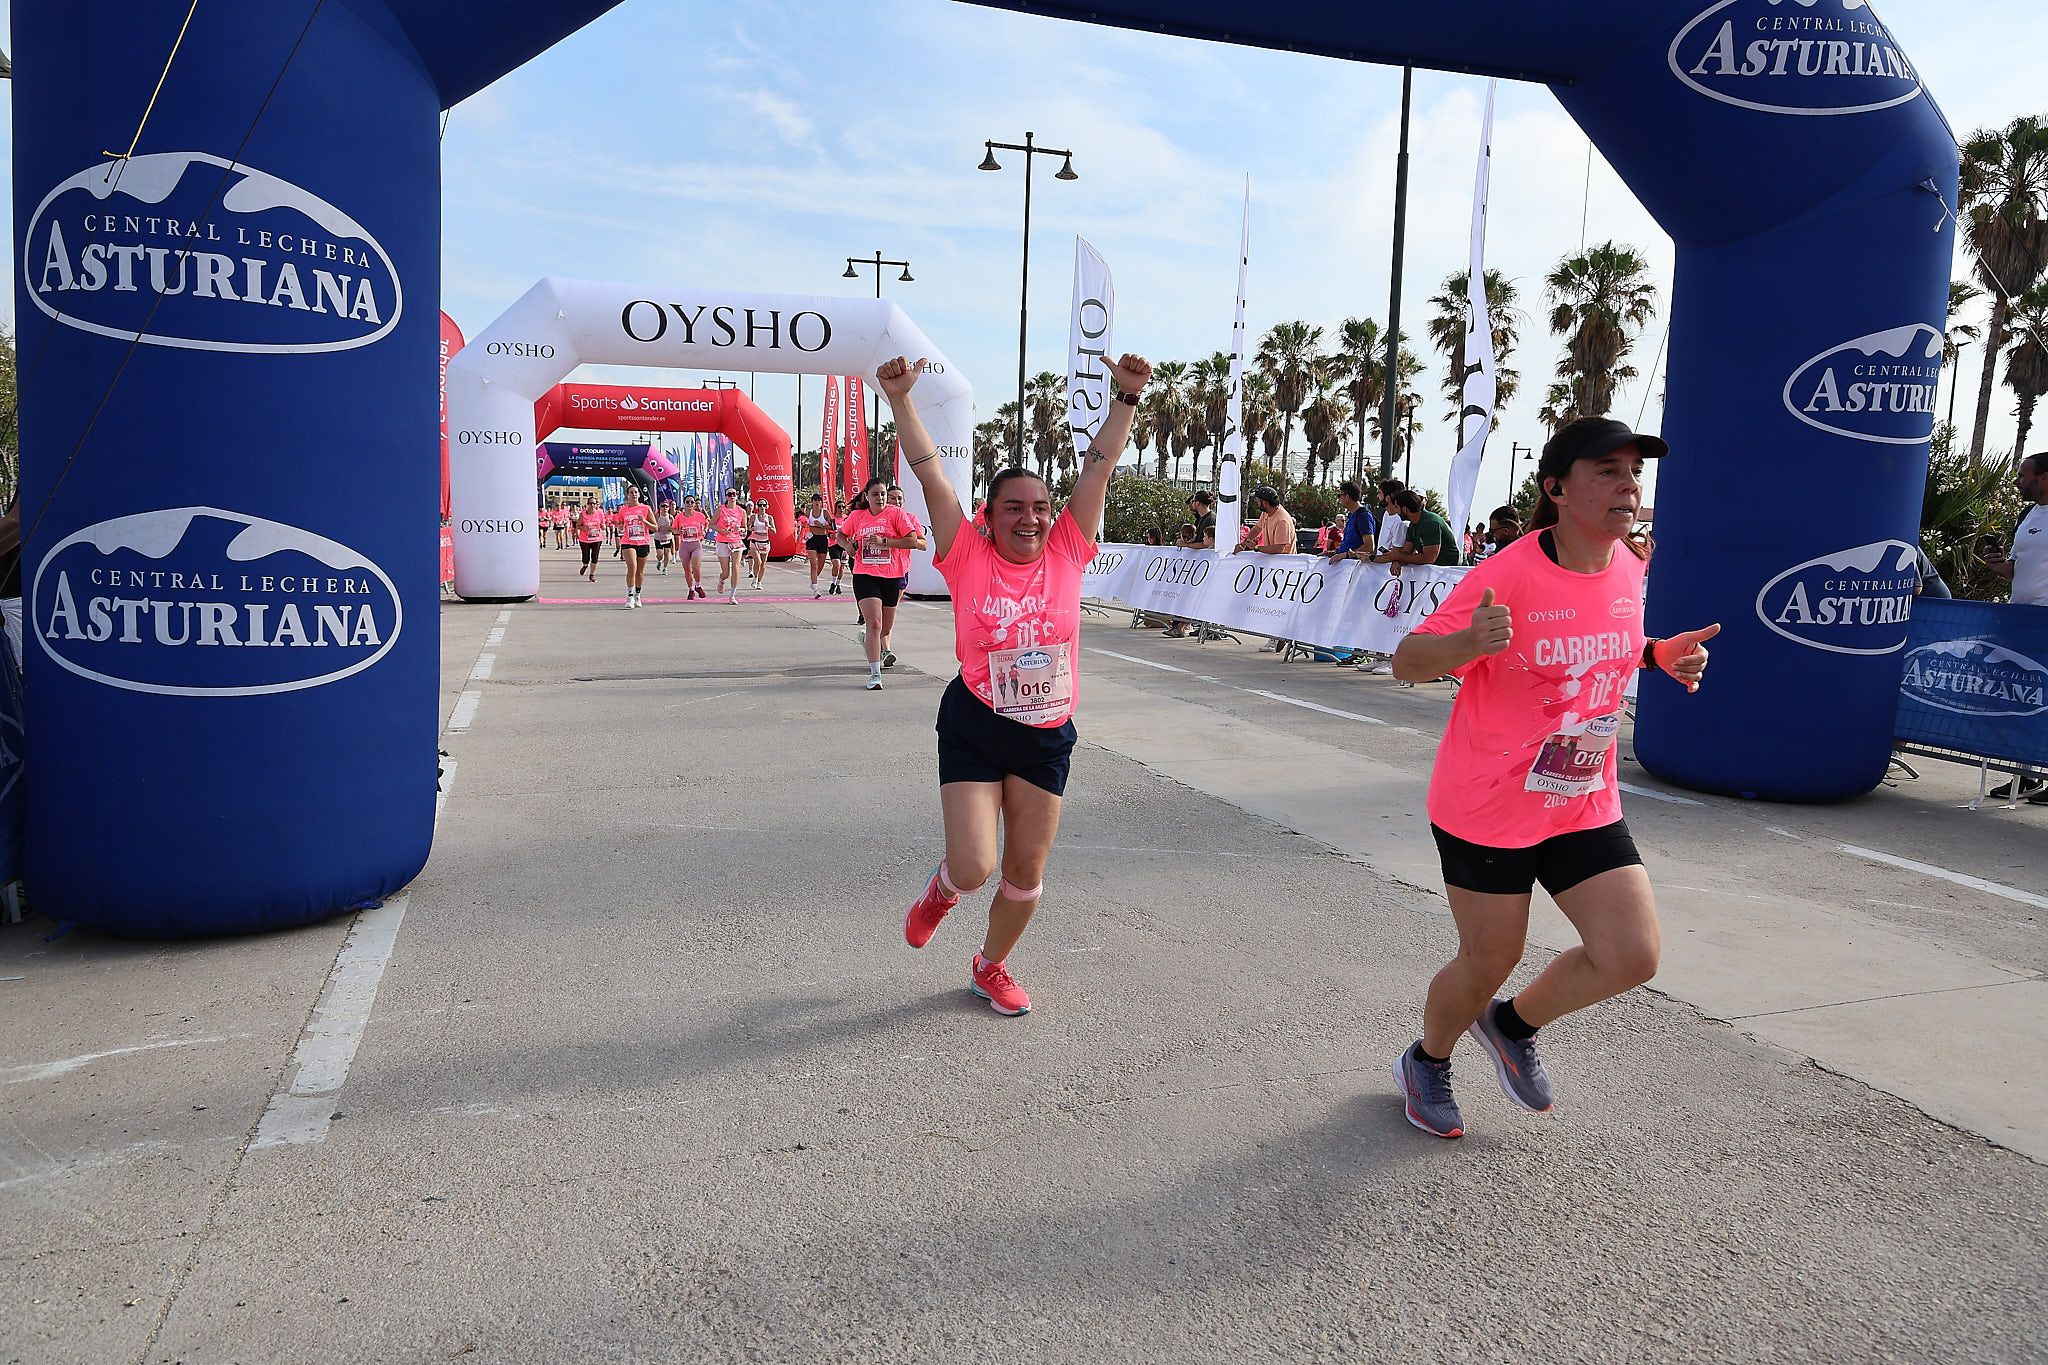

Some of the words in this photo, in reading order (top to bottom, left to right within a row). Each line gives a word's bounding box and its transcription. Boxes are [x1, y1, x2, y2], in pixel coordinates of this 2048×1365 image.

[1756, 17, 1844, 32] CENTRAL
[1689, 20, 1917, 81] ASTURIANA
[84, 214, 221, 241] CENTRAL
[238, 227, 371, 269] LECHERA
[39, 219, 382, 325] ASTURIANA
[621, 299, 833, 353] OYSHO
[486, 341, 555, 359] OYSHO
[1853, 364, 1922, 377] CENTRAL
[571, 394, 618, 411] Sports
[640, 397, 714, 412] Santander
[458, 430, 522, 445] OYSHO
[461, 519, 524, 533] OYSHO
[1144, 556, 1210, 587] OYSHO
[92, 568, 224, 591] CENTRAL
[240, 575, 371, 594] LECHERA
[1234, 564, 1324, 604] OYSHO
[1824, 579, 1894, 591] CENTRAL
[46, 570, 382, 648] ASTURIANA
[1528, 608, 1576, 623] OYSHO
[1535, 631, 1633, 667] CARRERA
[1018, 657, 1050, 667] ASTURIANA
[1021, 681, 1051, 697] 016
[1900, 658, 2045, 706] ASTURIANA
[1573, 750, 1605, 766] 016
[1537, 779, 1569, 792] OYSHO
